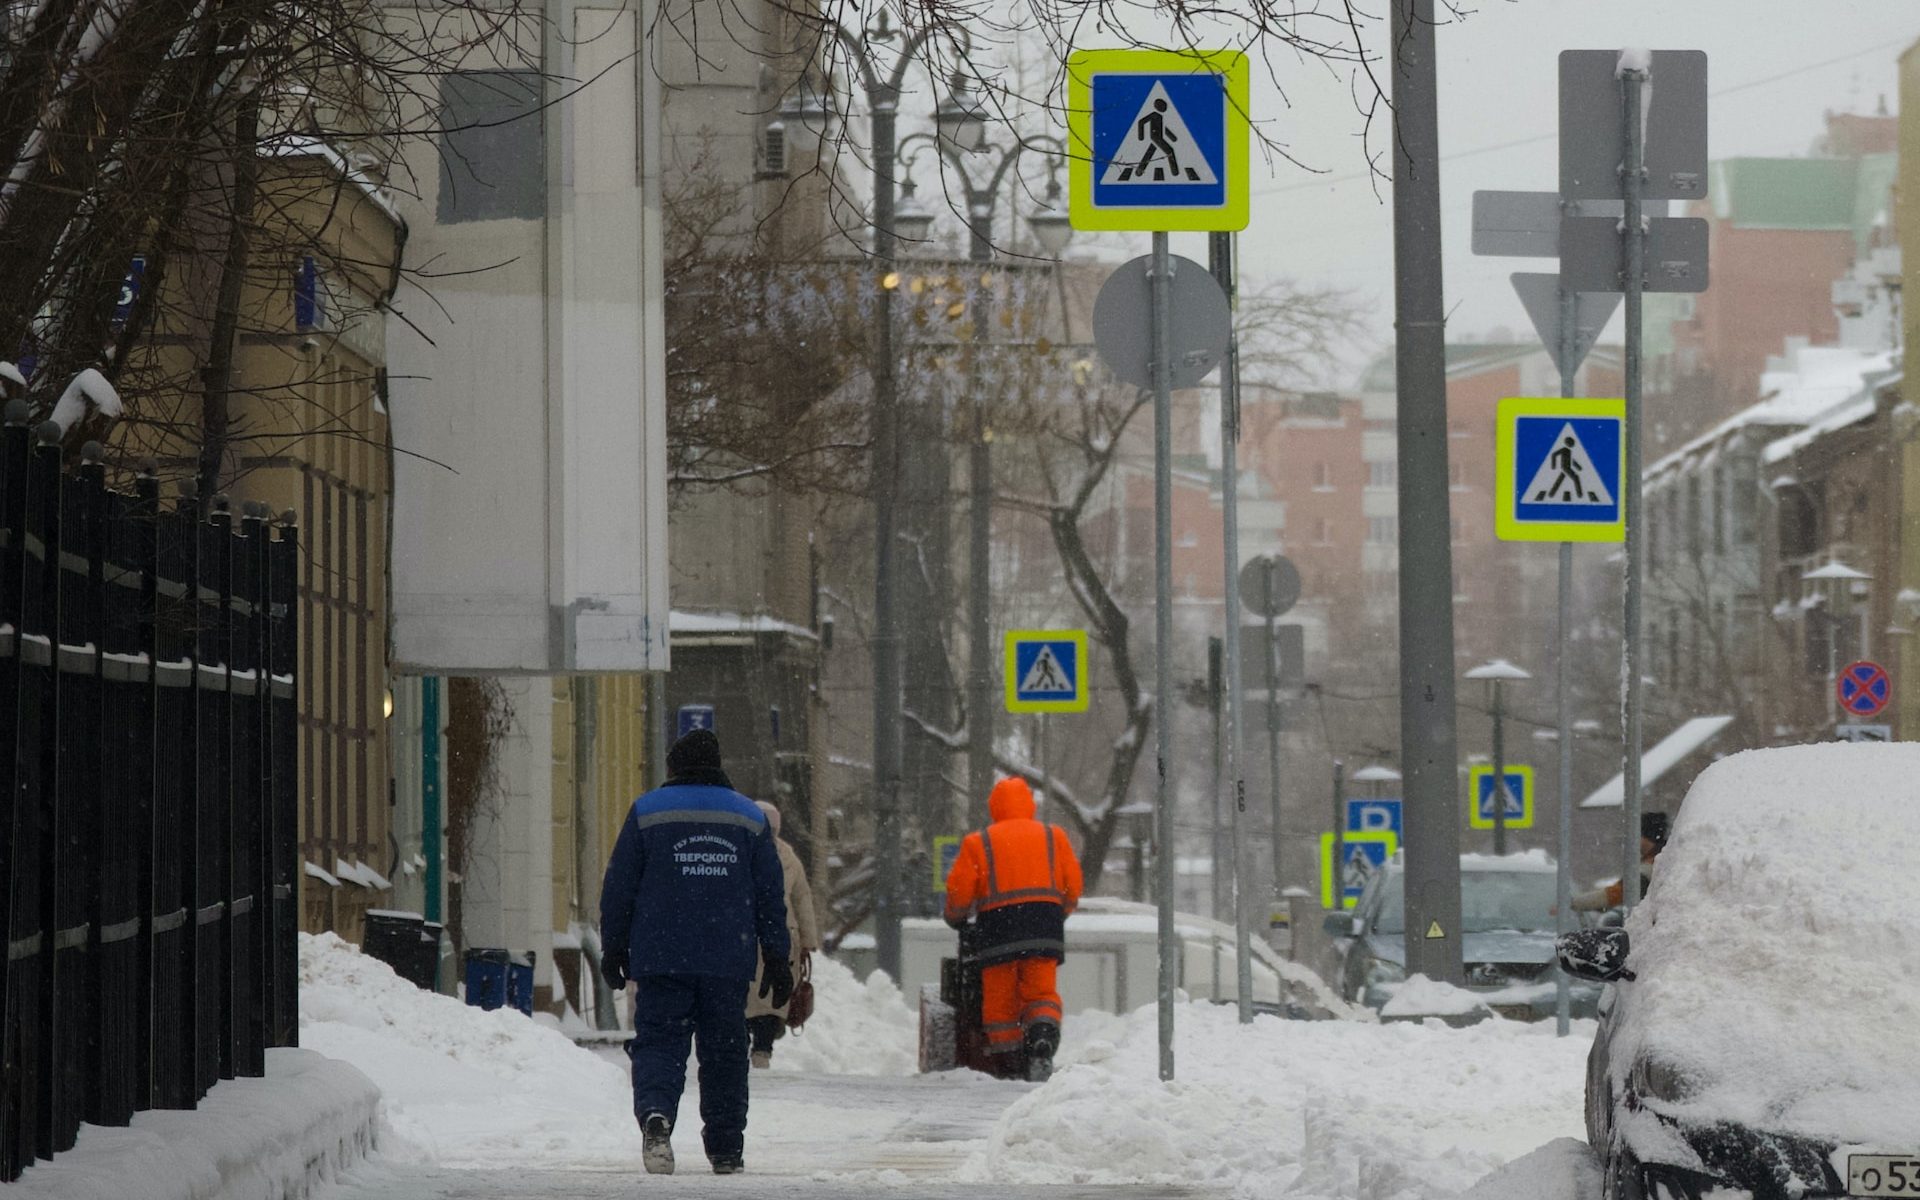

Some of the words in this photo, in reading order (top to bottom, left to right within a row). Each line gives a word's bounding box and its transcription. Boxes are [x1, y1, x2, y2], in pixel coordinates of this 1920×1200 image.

[1360, 806, 1392, 832] P
[673, 838, 688, 851] ГБУ
[673, 852, 738, 864] ТВЕРСКОГО
[682, 863, 729, 876] РАЙОНА
